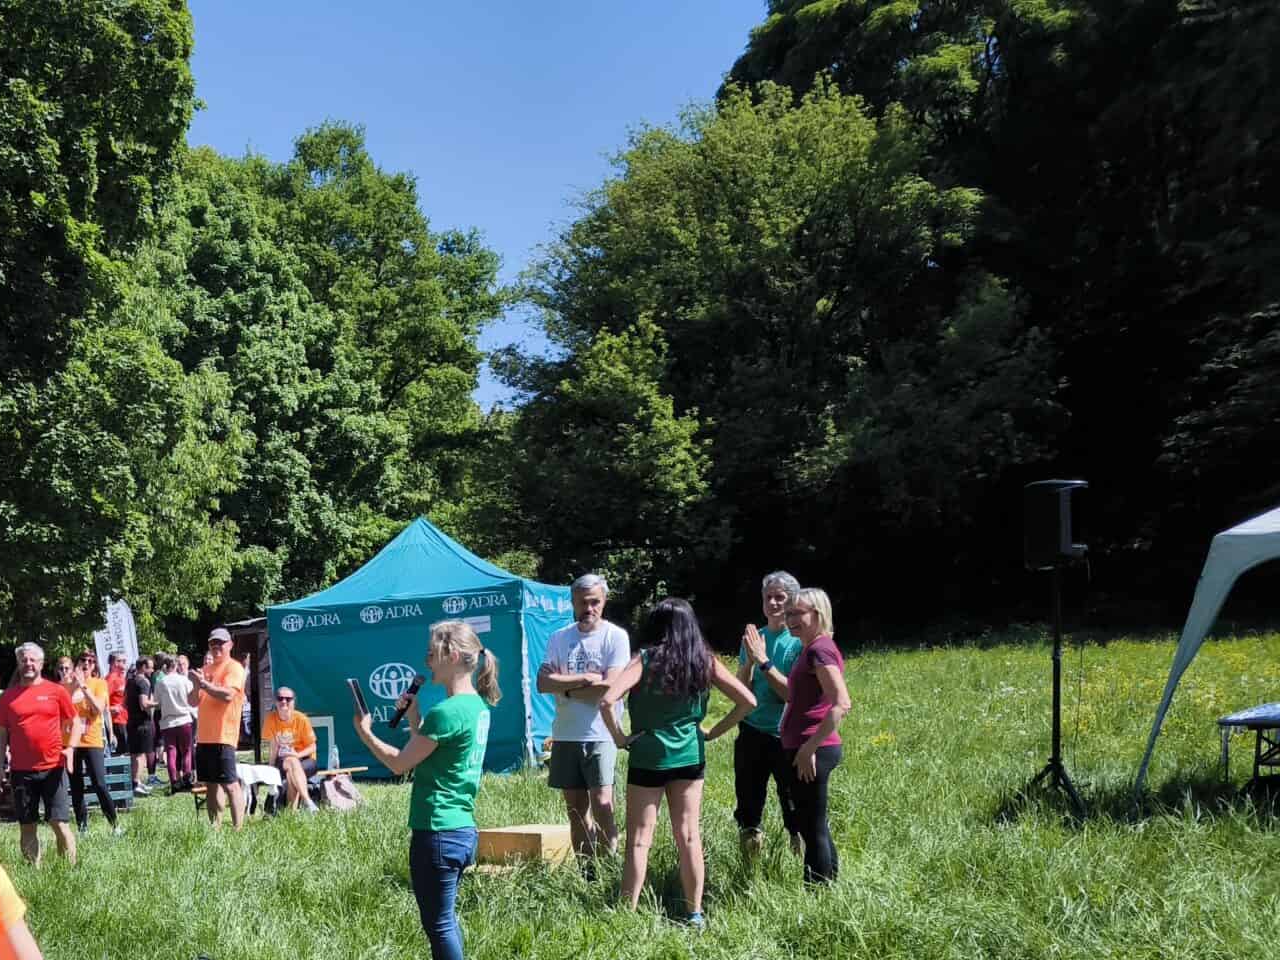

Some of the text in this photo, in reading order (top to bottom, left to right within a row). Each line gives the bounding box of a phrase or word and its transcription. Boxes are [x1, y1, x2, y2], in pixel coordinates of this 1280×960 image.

[469, 593, 508, 609] ADRA
[385, 603, 423, 619] ADRA
[306, 612, 342, 627] ADRA
